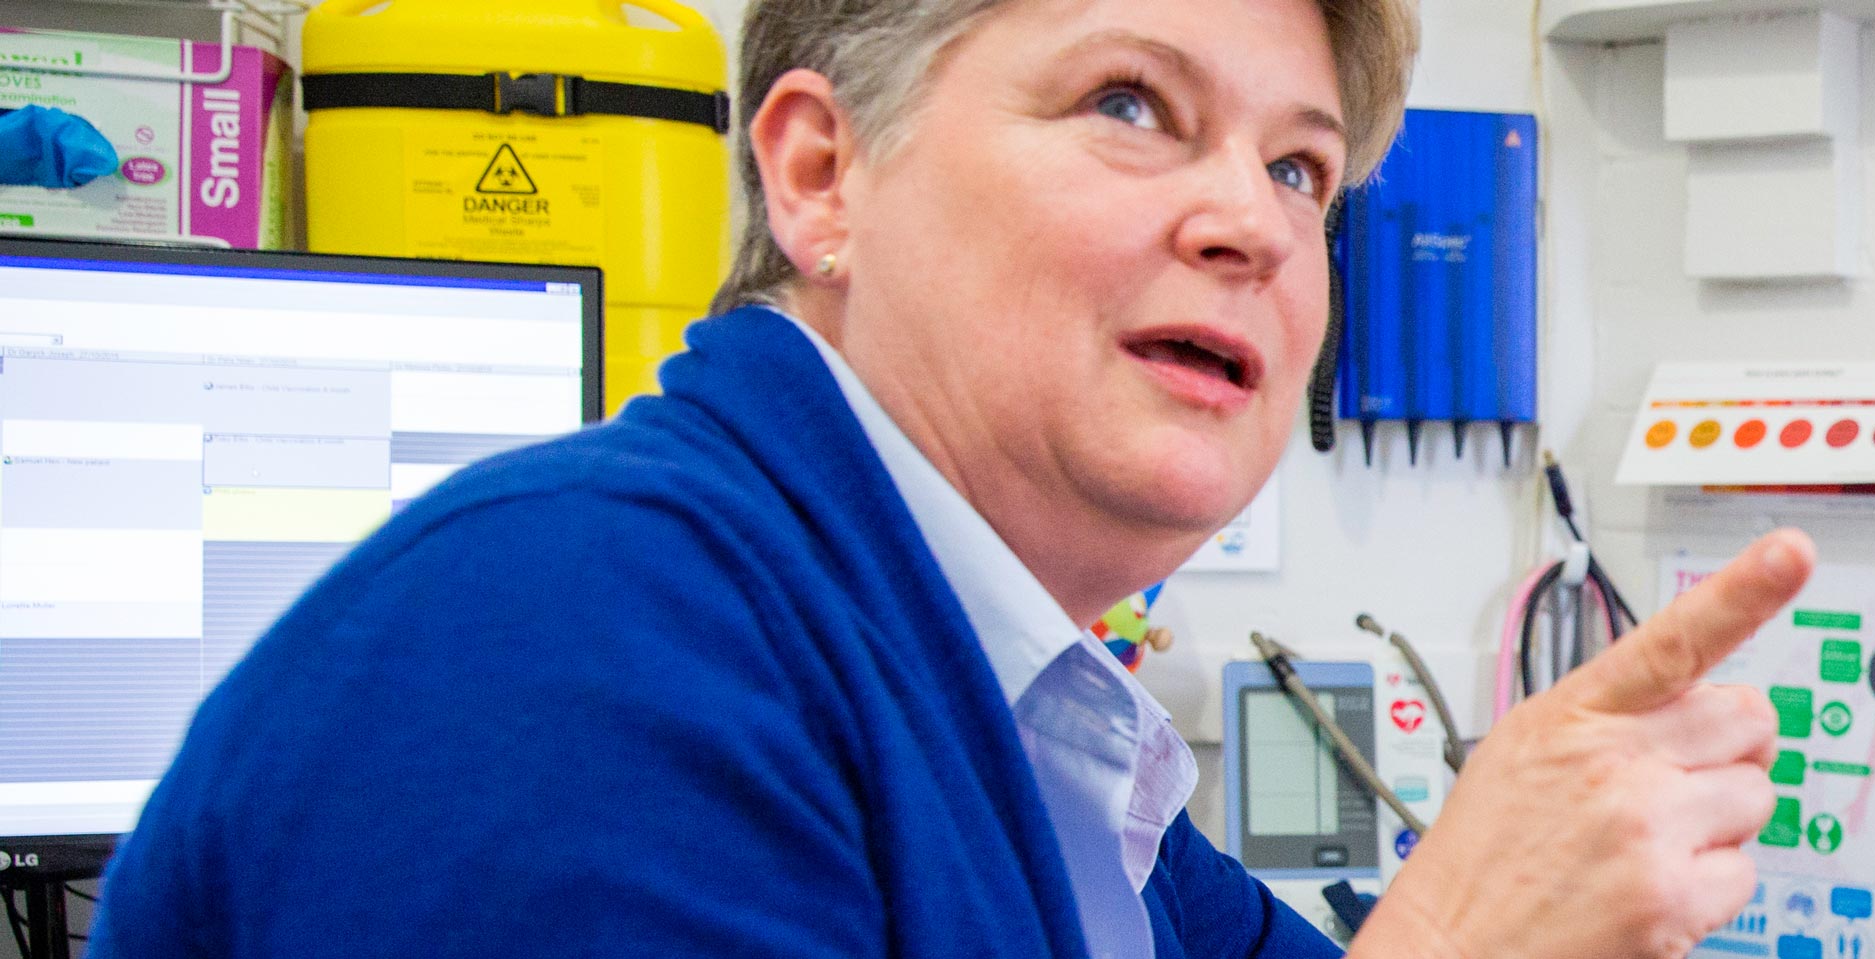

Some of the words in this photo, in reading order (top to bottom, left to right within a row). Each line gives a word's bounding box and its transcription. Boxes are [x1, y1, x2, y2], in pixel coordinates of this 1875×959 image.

[200, 88, 241, 209] Small
[463, 198, 550, 214] DANGER
[14, 853, 40, 867] LG
